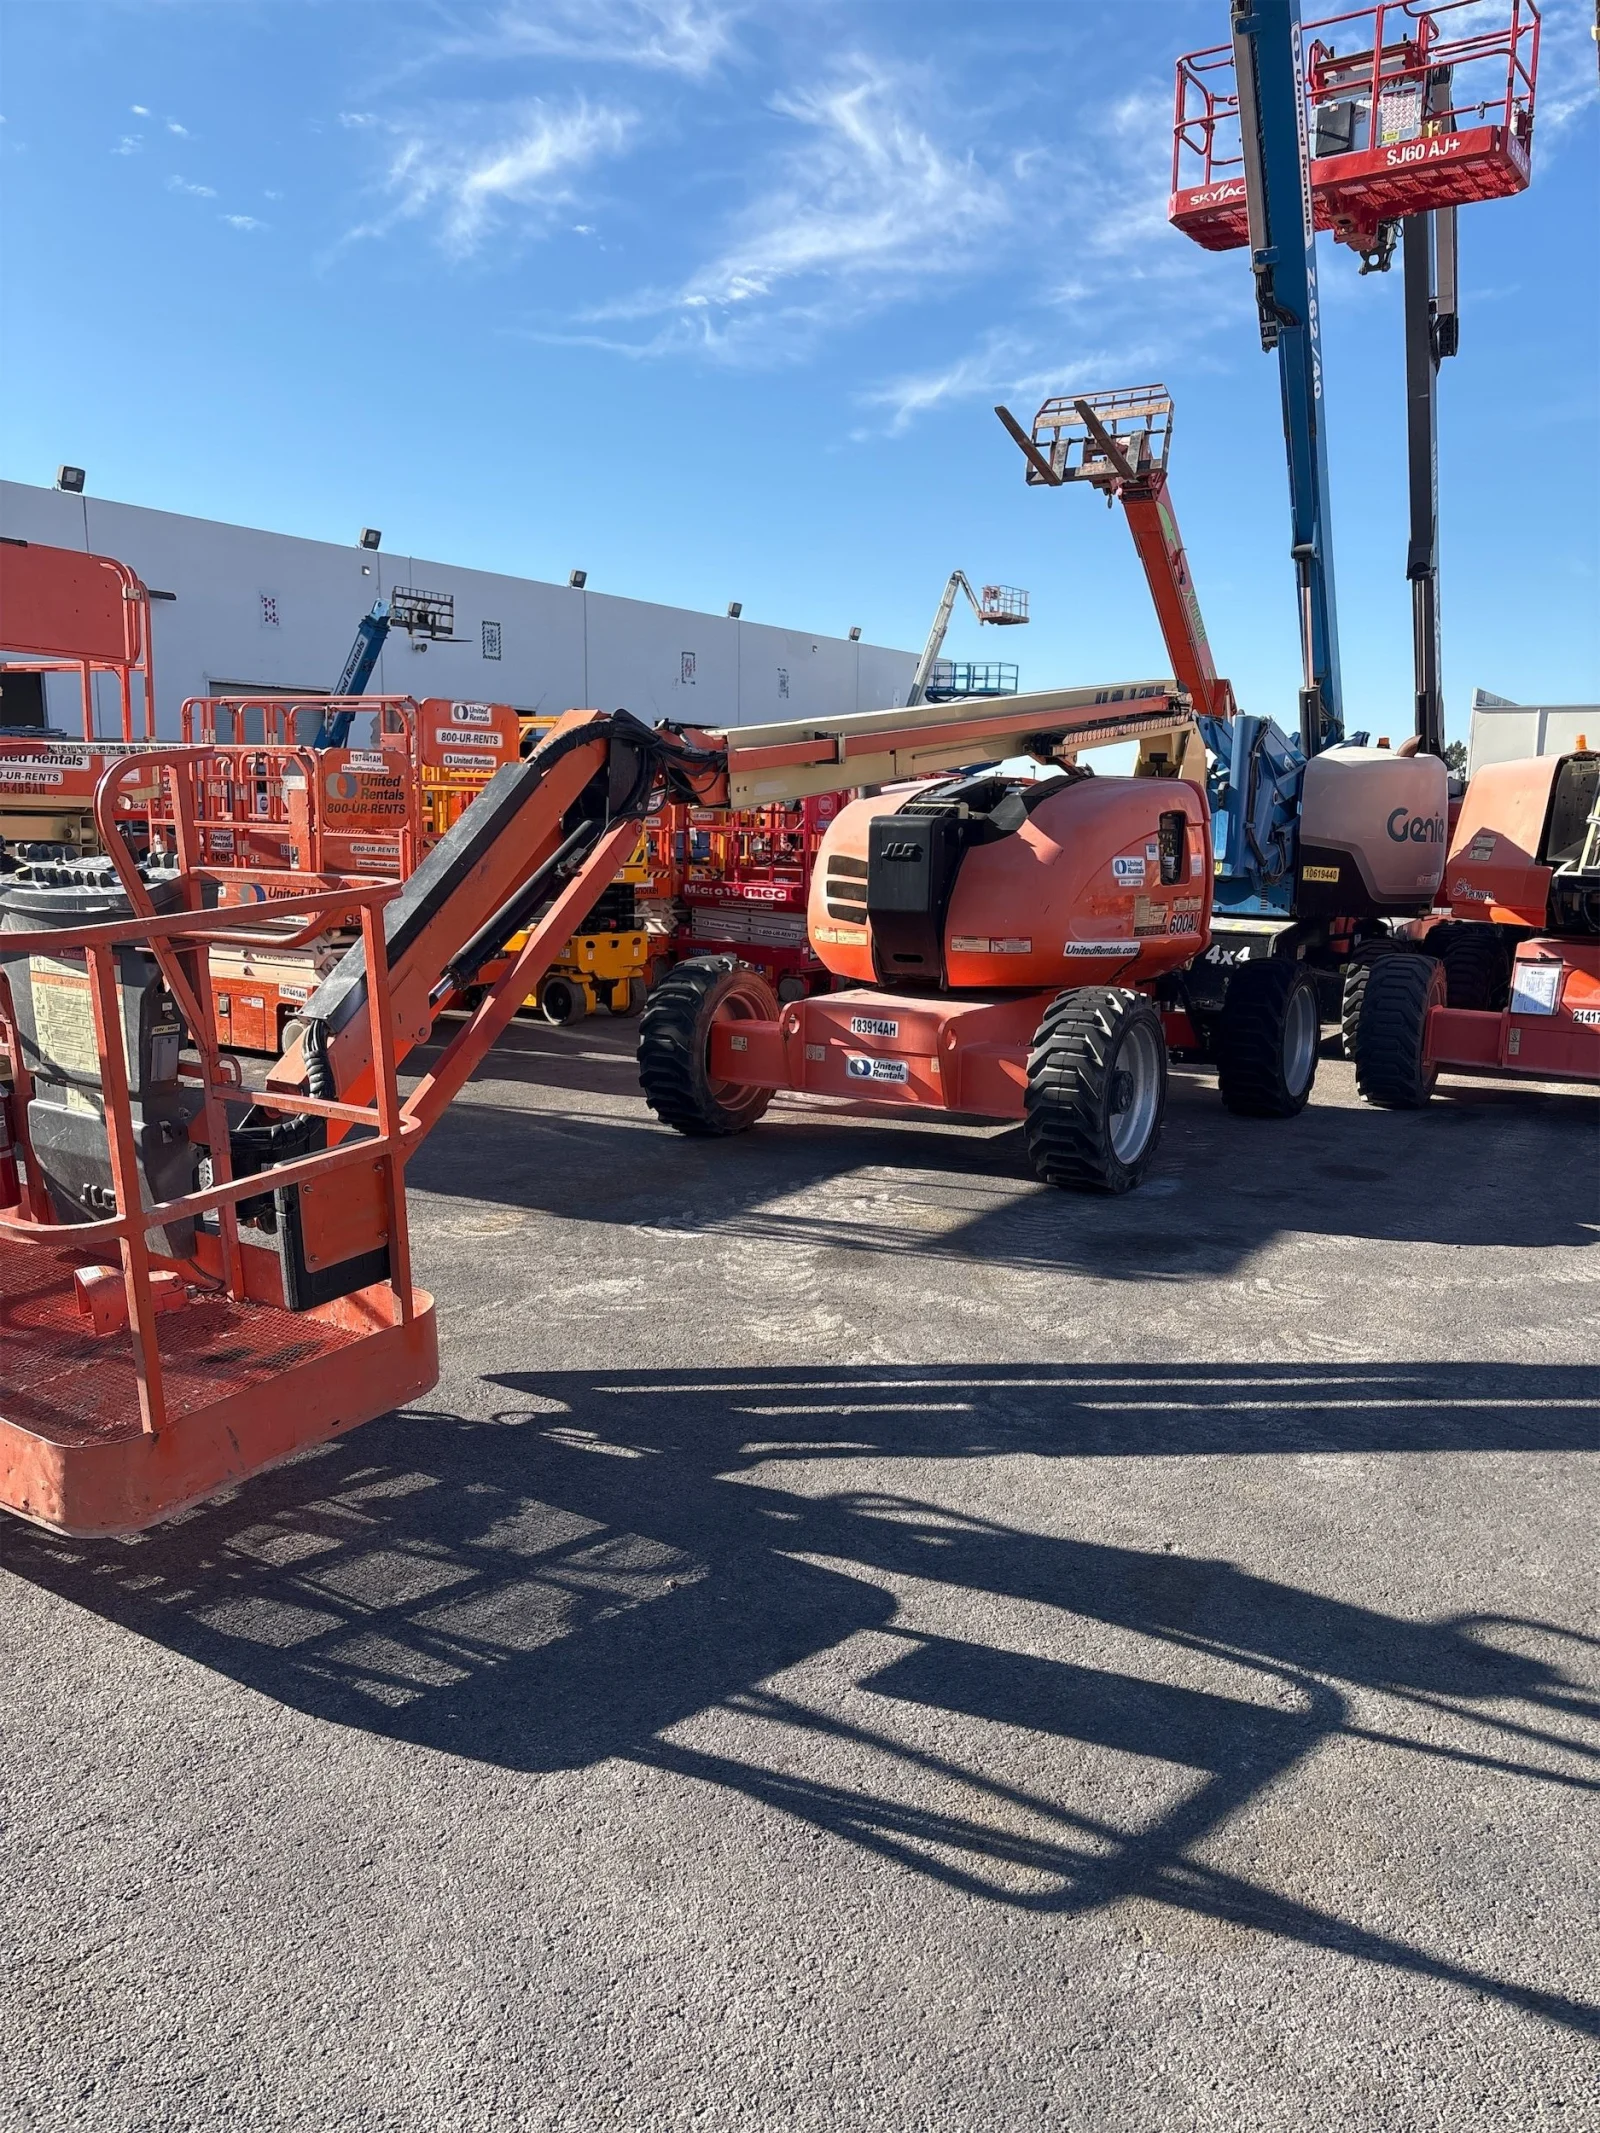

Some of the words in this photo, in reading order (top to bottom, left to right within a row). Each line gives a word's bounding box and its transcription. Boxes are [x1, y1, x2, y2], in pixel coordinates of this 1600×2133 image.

[1296, 69, 1306, 146] United
[1302, 154, 1312, 237] Rentals
[1387, 144, 1425, 166] SJ60
[1428, 138, 1461, 158] AJ+
[1190, 182, 1246, 205] SKYJAC
[346, 640, 365, 679] Rentals
[469, 706, 488, 714] United
[469, 714, 490, 722] Rentals
[441, 732, 498, 745] 800-UR-RENTS
[32, 754, 83, 766] Rentals
[454, 756, 472, 764] United
[473, 757, 494, 765] Rentals
[361, 773, 401, 787] United
[361, 788, 404, 801] Rentals
[327, 803, 406, 814] 800-UR-RENTS
[1387, 807, 1445, 843] Genie
[210, 833, 232, 841] United
[210, 841, 233, 849] Rentals
[352, 845, 399, 854] 800-UR-RENTS
[881, 842, 918, 858] JLG
[1305, 869, 1337, 880] 10619440
[268, 886, 305, 899] United
[744, 887, 786, 900] mec
[1169, 913, 1201, 936] 600AJ
[1065, 945, 1139, 955] UnitedRentals.com
[1205, 945, 1251, 966] 4x4
[280, 987, 307, 998] 197441AH
[1573, 1011, 1600, 1023] 21417
[851, 1018, 896, 1036] 183914AH
[873, 1061, 902, 1072] United
[873, 1070, 905, 1081] Rentals
[80, 1183, 117, 1212] JLG
